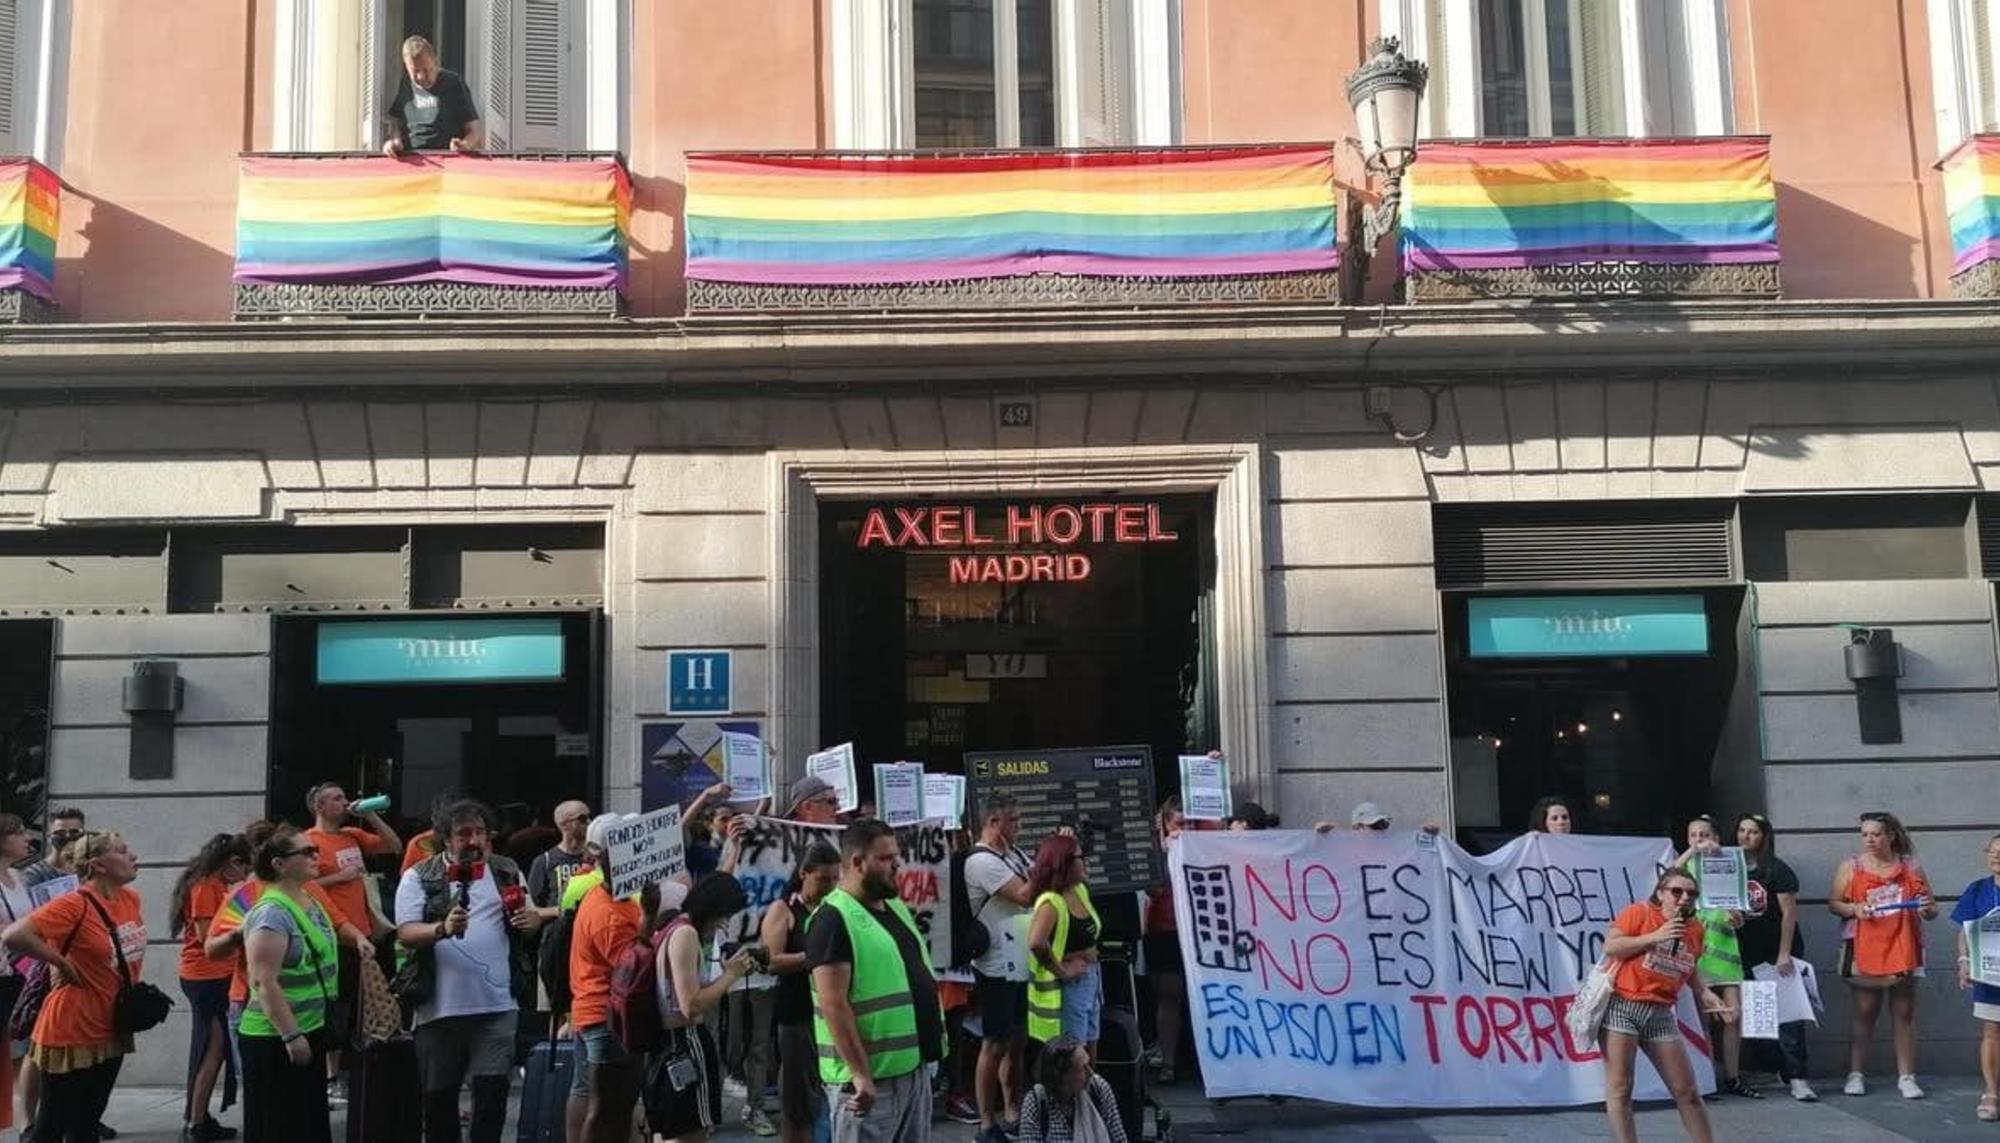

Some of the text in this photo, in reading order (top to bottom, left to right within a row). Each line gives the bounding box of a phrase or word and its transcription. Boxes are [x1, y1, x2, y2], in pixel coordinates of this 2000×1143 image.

[857, 503, 1178, 548] AXEL HOTEL
[950, 554, 1091, 583] MADRID
[686, 657, 714, 691] H
[997, 760, 1049, 777] SALIDAS
[1094, 756, 1142, 769] Blackstone
[1245, 858, 1666, 927] NO ES MARBELL
[1257, 933, 1352, 996] NO
[1368, 930, 1434, 989] ES
[1451, 929, 1551, 993] NEW
[1557, 930, 1606, 981] YO
[1201, 983, 1250, 1021] ES
[1206, 993, 1605, 1067] UN PISO EN TORRE
